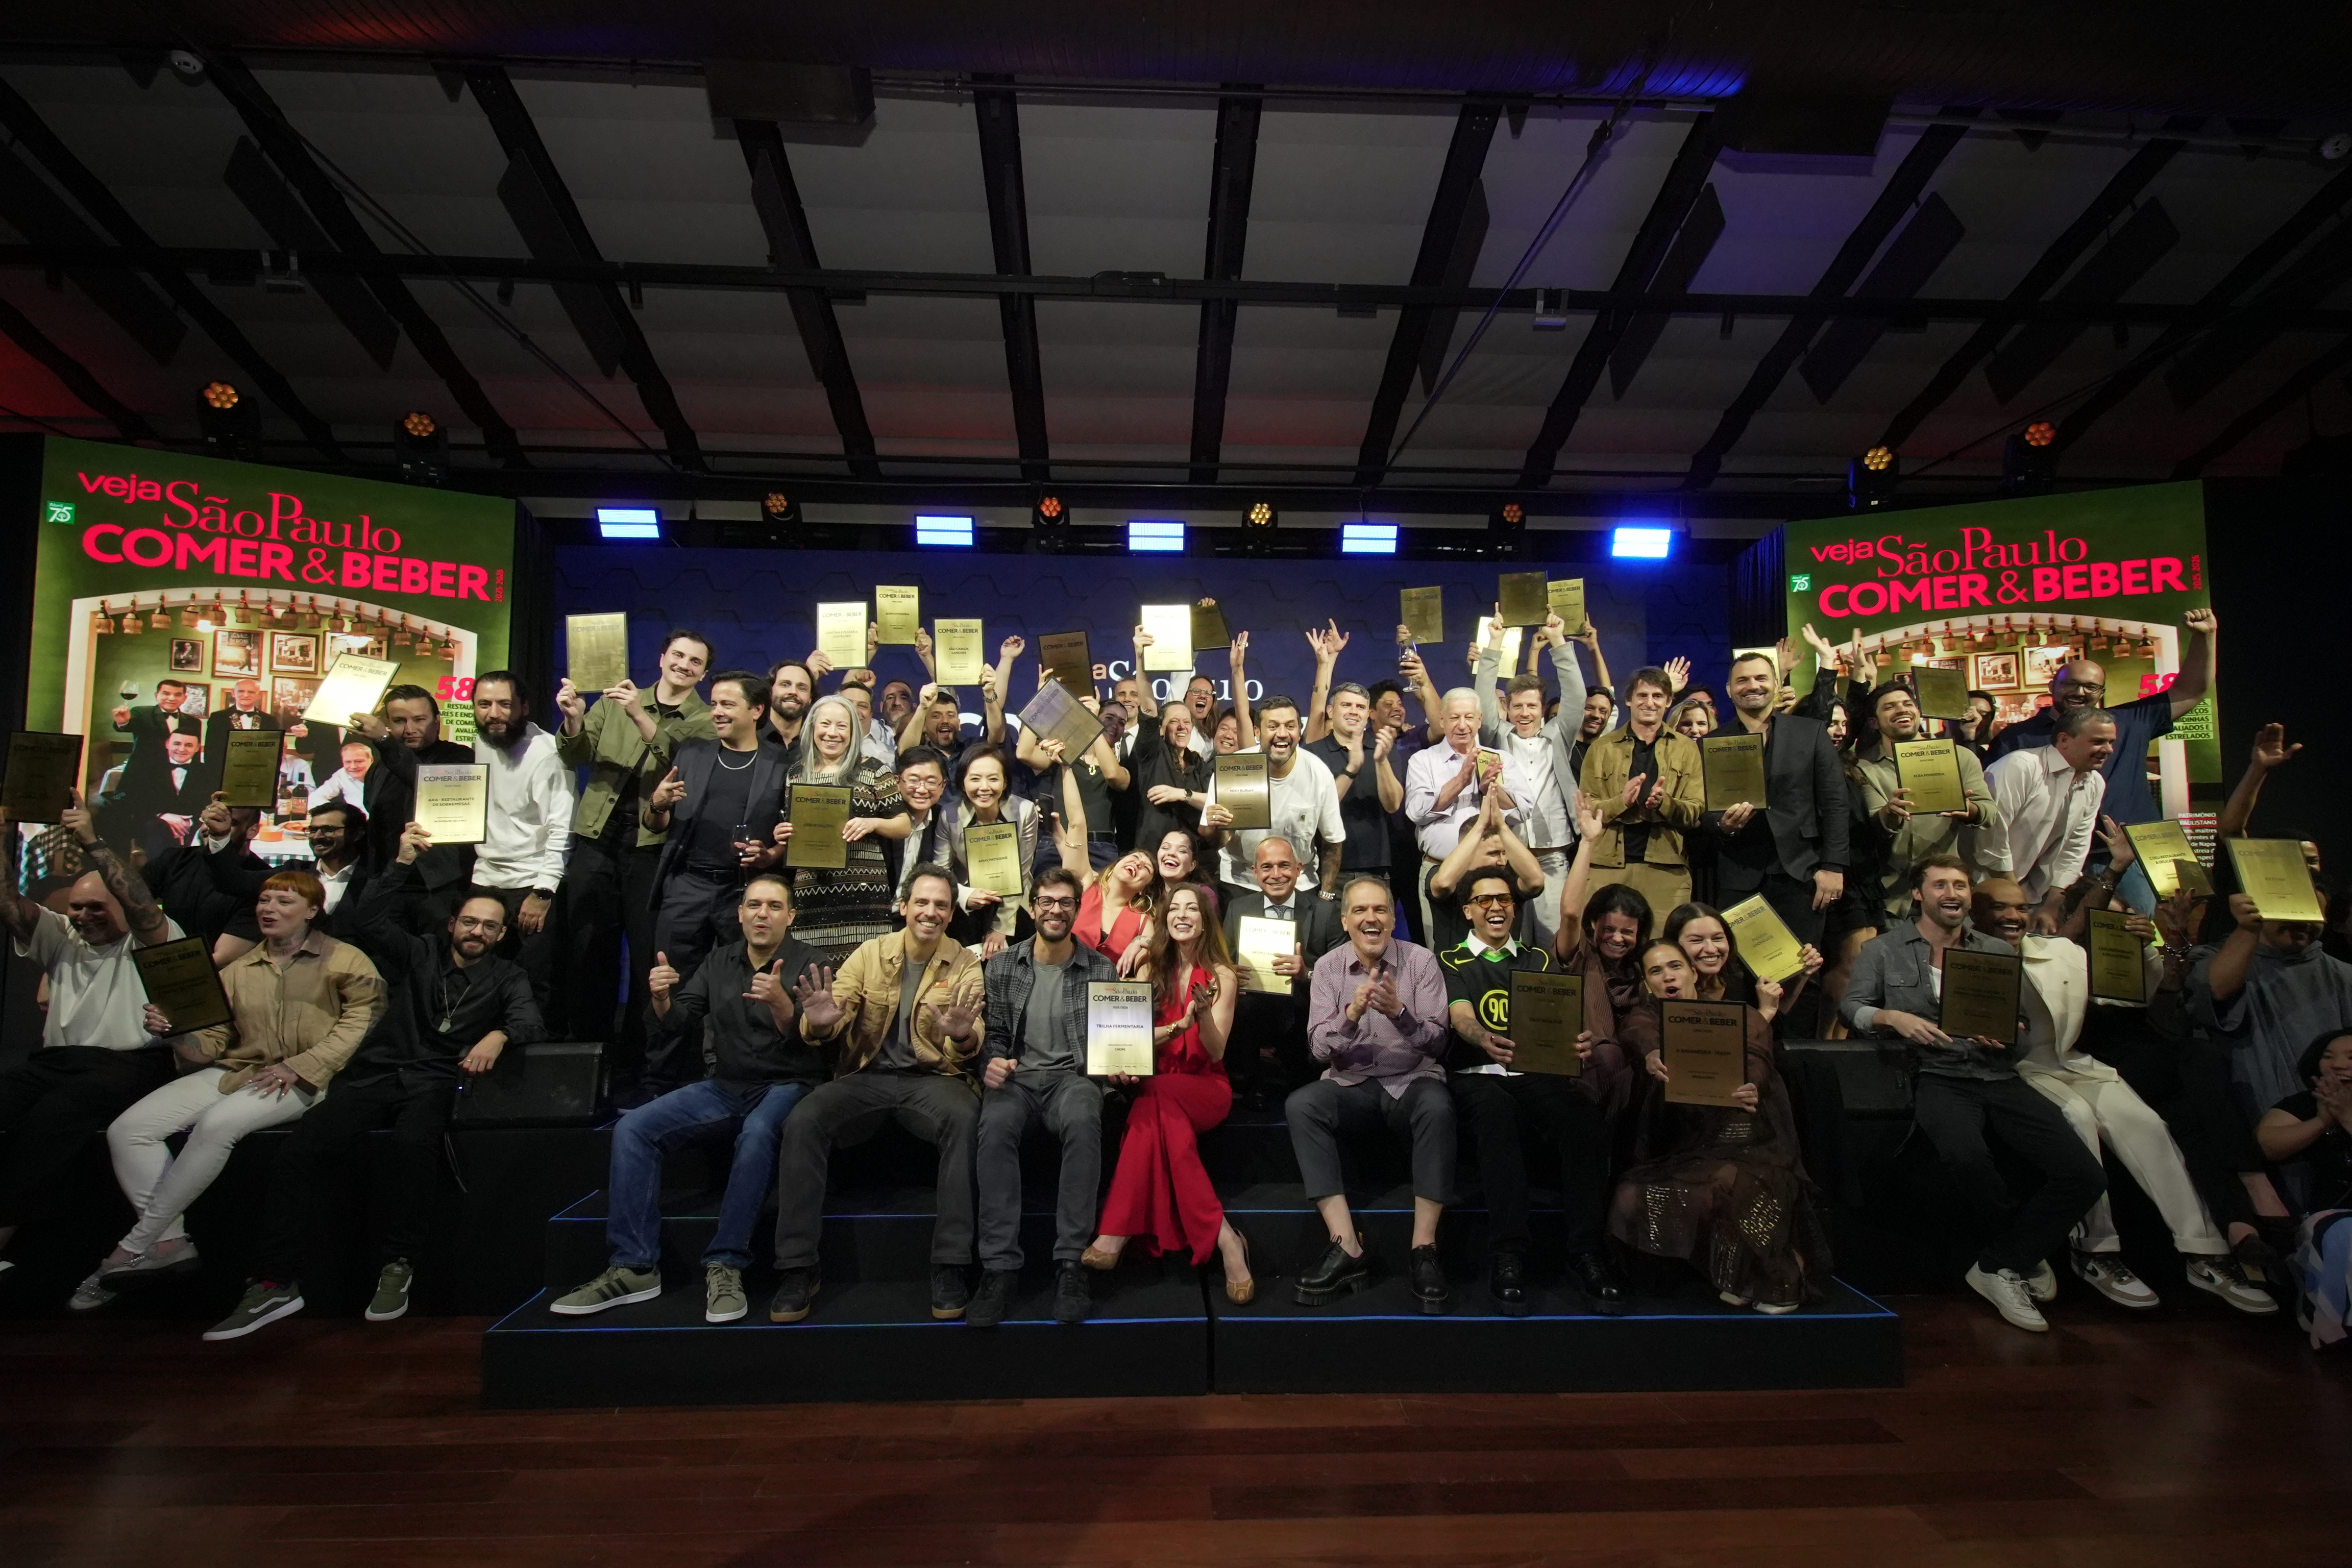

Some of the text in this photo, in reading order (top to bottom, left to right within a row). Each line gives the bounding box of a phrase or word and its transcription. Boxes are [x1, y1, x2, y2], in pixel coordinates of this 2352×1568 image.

[48, 506, 72, 522] 75
[79, 473, 401, 553] veja São Paulo
[83, 524, 491, 602] COMER & BEBER
[1811, 527, 2088, 578] veja São Paulo
[1792, 577, 1809, 592] 75
[1819, 557, 2188, 618] COMER & BEBER
[339, 663, 363, 673] COMER
[368, 668, 387, 676] BEBER
[435, 675, 476, 701] 58
[1028, 688, 1060, 723] COMER BEBER
[1728, 917, 1745, 928] OMER
[1747, 906, 1766, 918] BEBER
[2093, 921, 2115, 929] COMER
[1517, 985, 1546, 994] COMER
[1668, 1016, 1702, 1024] COMER
[1709, 1018, 1737, 1026] BEBER
